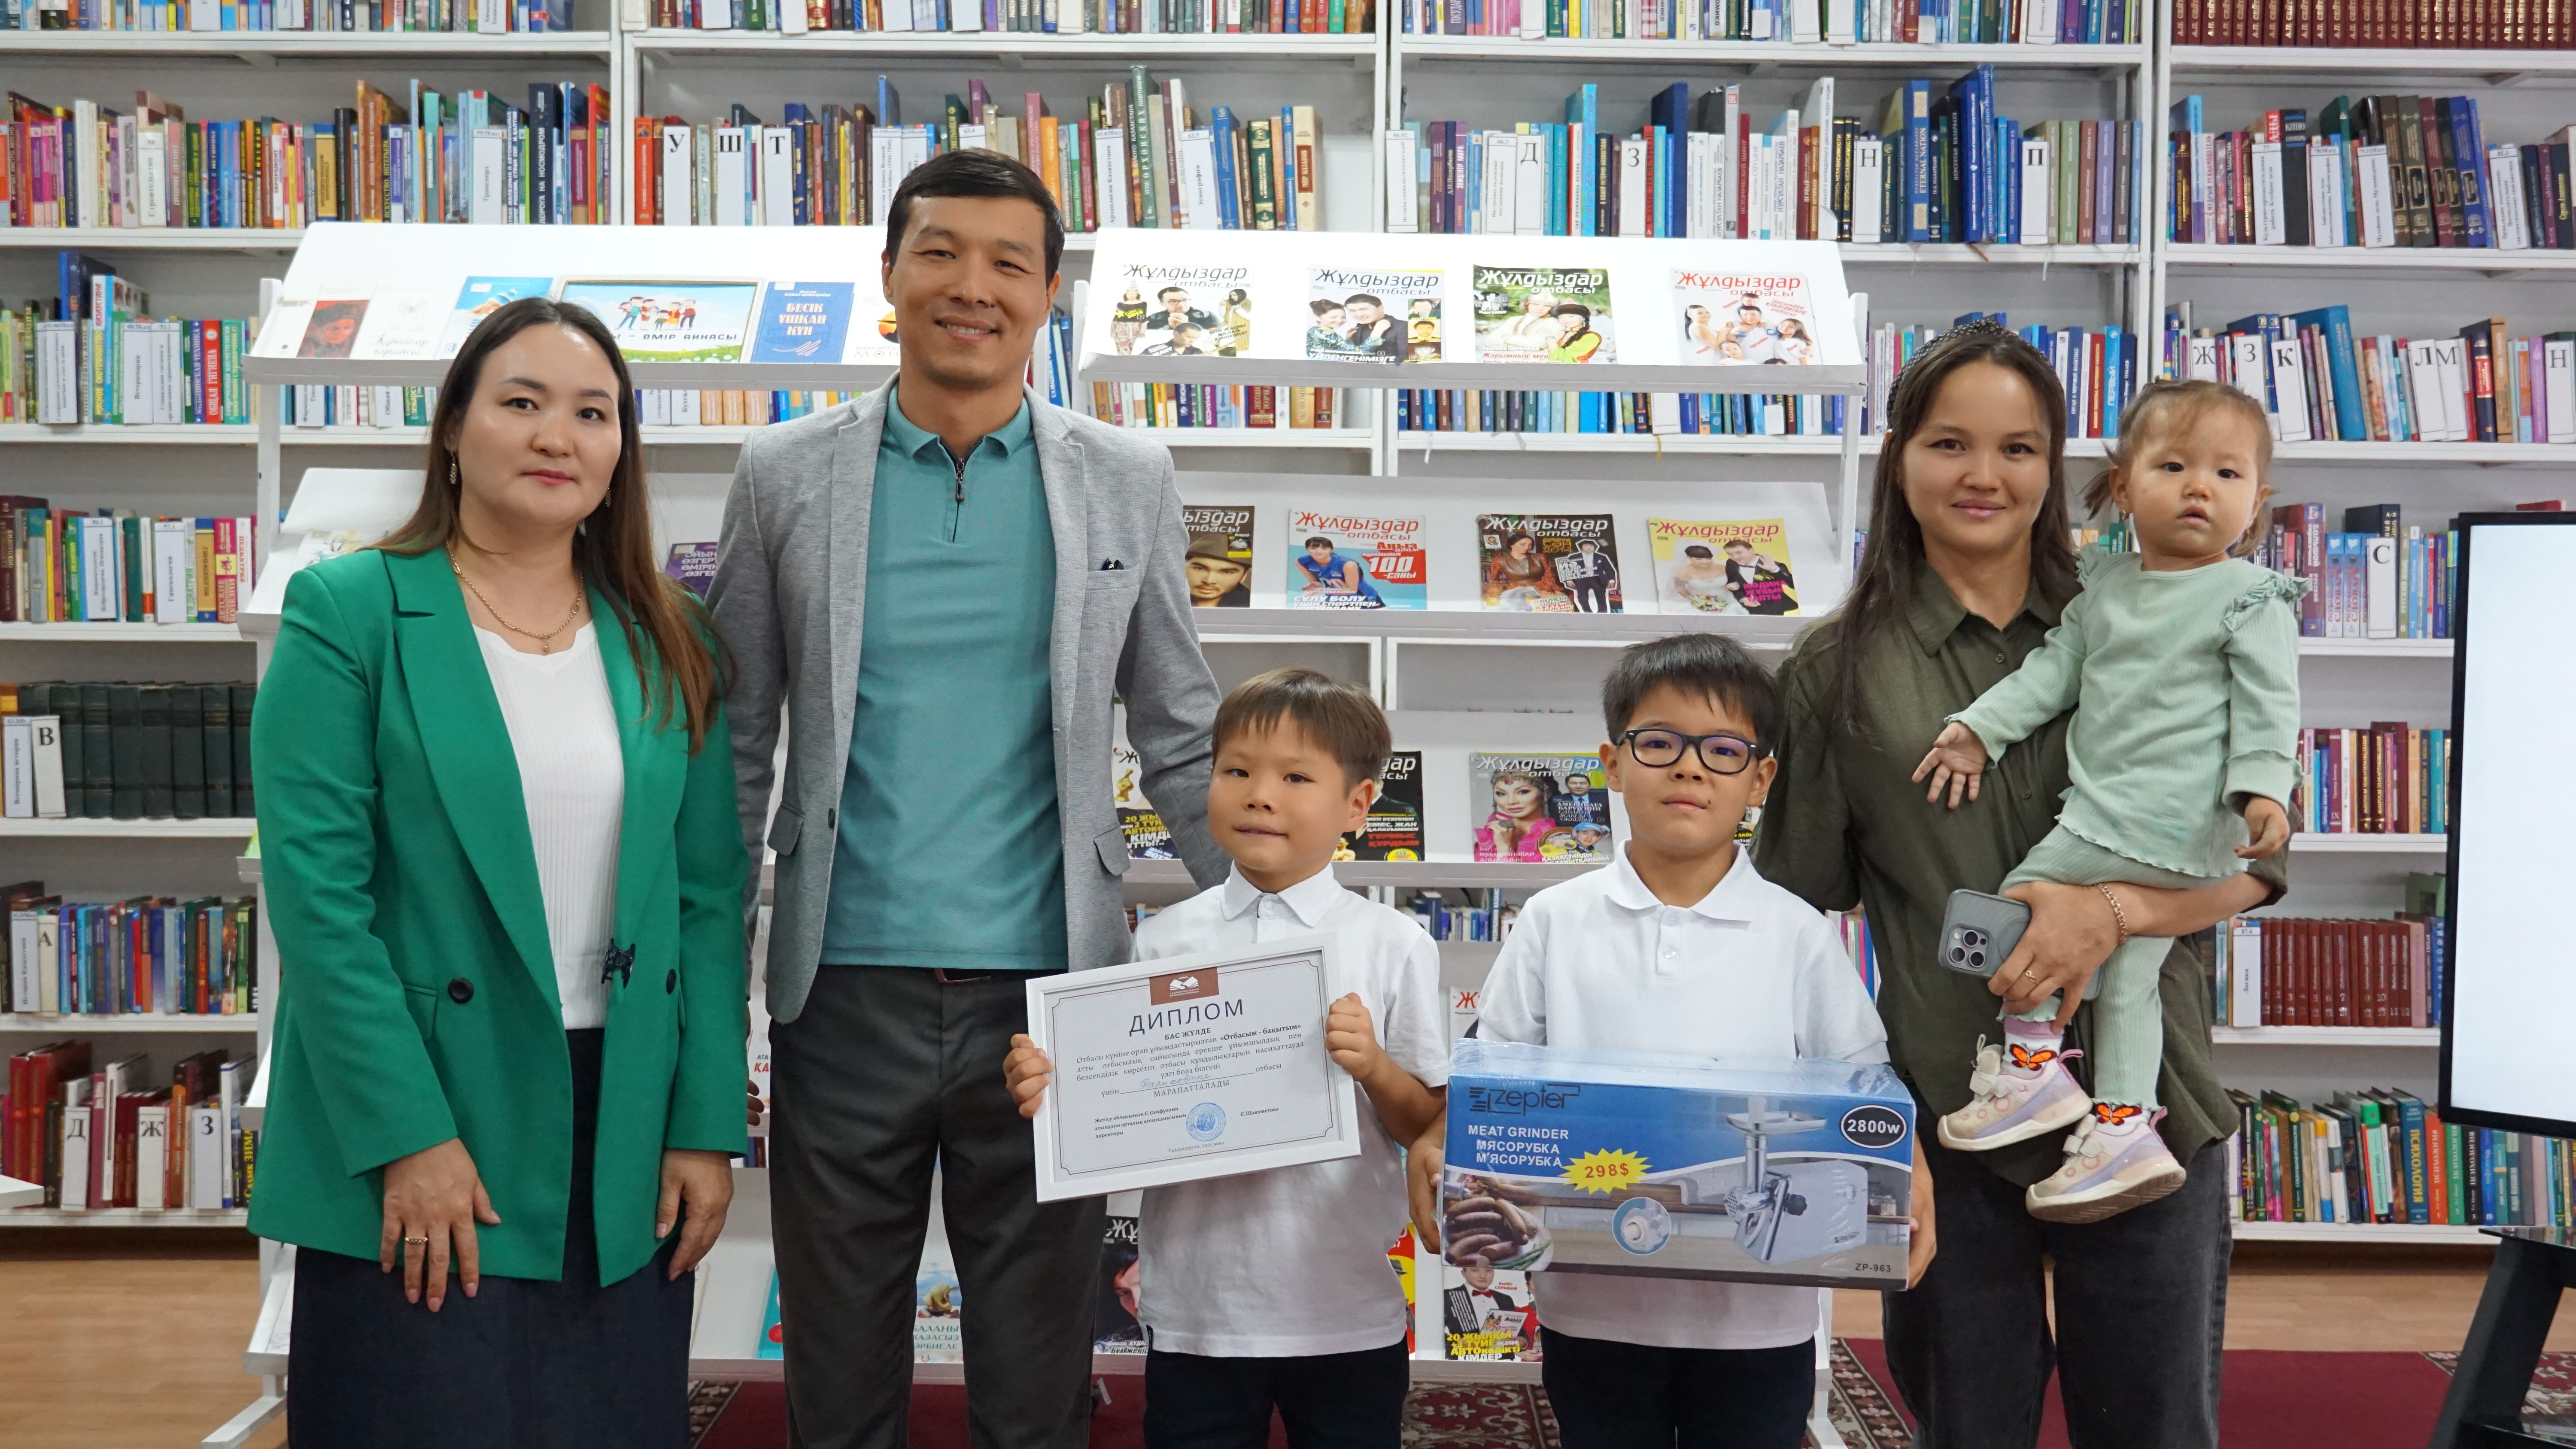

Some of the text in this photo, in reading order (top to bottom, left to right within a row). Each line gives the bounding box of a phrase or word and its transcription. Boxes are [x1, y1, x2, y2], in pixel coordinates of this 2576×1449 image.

[668, 134, 685, 153] У
[719, 135, 741, 152] Ш
[770, 136, 786, 155] Т
[1456, 146, 1464, 161] МИРА
[1520, 143, 1538, 166] Д
[1627, 148, 1640, 167] З
[1862, 149, 1877, 168] Н
[2028, 149, 2043, 166] П
[539, 181, 546, 191] НА
[1123, 264, 1248, 282] Жұлдыздар
[1315, 269, 1439, 288] Жұлдыздар
[1478, 269, 1603, 288] Жұлдыздар
[1677, 272, 1801, 290] Жұлдыздар
[786, 302, 824, 313] БЕСІК
[778, 314, 826, 325] ҰШҚАН
[787, 325, 813, 336] КҮН
[2193, 346, 2216, 365] Ж
[2243, 343, 2256, 363] З
[2275, 348, 2294, 367] К
[2415, 346, 2433, 367] Л
[2436, 346, 2458, 367] М
[2550, 349, 2568, 368] Н
[208, 349, 219, 415] ОБЩАЯ ГИГИЕНА
[2108, 366, 2116, 406] ПЕРВЫЙ
[1183, 512, 1250, 527] ыздар
[1295, 511, 1419, 534] Жұлдыздар
[1484, 516, 1608, 533] Жұлдыздар
[1347, 532, 1411, 541] отбасы
[1656, 521, 1779, 538] Жұлдыздар
[2372, 545, 2390, 564] С
[1369, 556, 1414, 573] 100
[187, 568, 196, 615] ПЕДИАТРИЯ
[38, 727, 54, 746] В
[1476, 756, 1600, 773] Жұлдыздар
[38, 931, 53, 947] А
[1128, 999, 1244, 1037] ДИПЛОМ
[1165, 1028, 1211, 1040] БАС ЖҮЛДЕ
[1077, 1054, 1103, 1063] Отбасы
[1106, 1050, 1129, 1061] күніне
[1131, 1047, 1148, 1057] орай
[1150, 1036, 1217, 1054] ұйымдастырылған
[1220, 1030, 1257, 1041] «Отбасым
[1263, 1025, 1301, 1036] бақытым»
[1103, 1058, 1142, 1069] отбасылық
[1150, 1050, 1191, 1061] сайысында
[1195, 1045, 1222, 1055] ерекше
[1229, 1036, 1280, 1050] ұйымшылдық
[1076, 1042, 1304, 1082] белсенділік көрсетіп, отбасы құндылықтарын насихаттауда
[1161, 1071, 1175, 1079] үлгі
[1194, 1063, 1220, 1073] білгені
[1101, 1063, 1282, 1097] үшін отбасы
[1154, 1080, 1230, 1097] МАРАПАТТАЛАДЫ
[1095, 1123, 1120, 1131] атындағы
[1144, 1113, 1186, 1124] кітапханасының
[1113, 1112, 1144, 1120] облысының
[1145, 1106, 1179, 1116] С.Сейфуллин
[1240, 1107, 1279, 1116] С.Шаяхметова
[66, 1118, 86, 1141] Д
[140, 1120, 164, 1137] Ж
[202, 1116, 213, 1135] З
[1468, 1124, 1569, 1140] MEAT GRINDER
[1095, 1131, 1123, 1139] директоры
[1168, 1144, 1201, 1153] Талдықорған,
[1476, 1140, 1561, 1155] МЯСОРУБКА
[1584, 1163, 1630, 1179] 298$
[2412, 1128, 2422, 1204] ПСИХОЛОГИЯ
[1854, 1262, 1892, 1273] ZP-963
